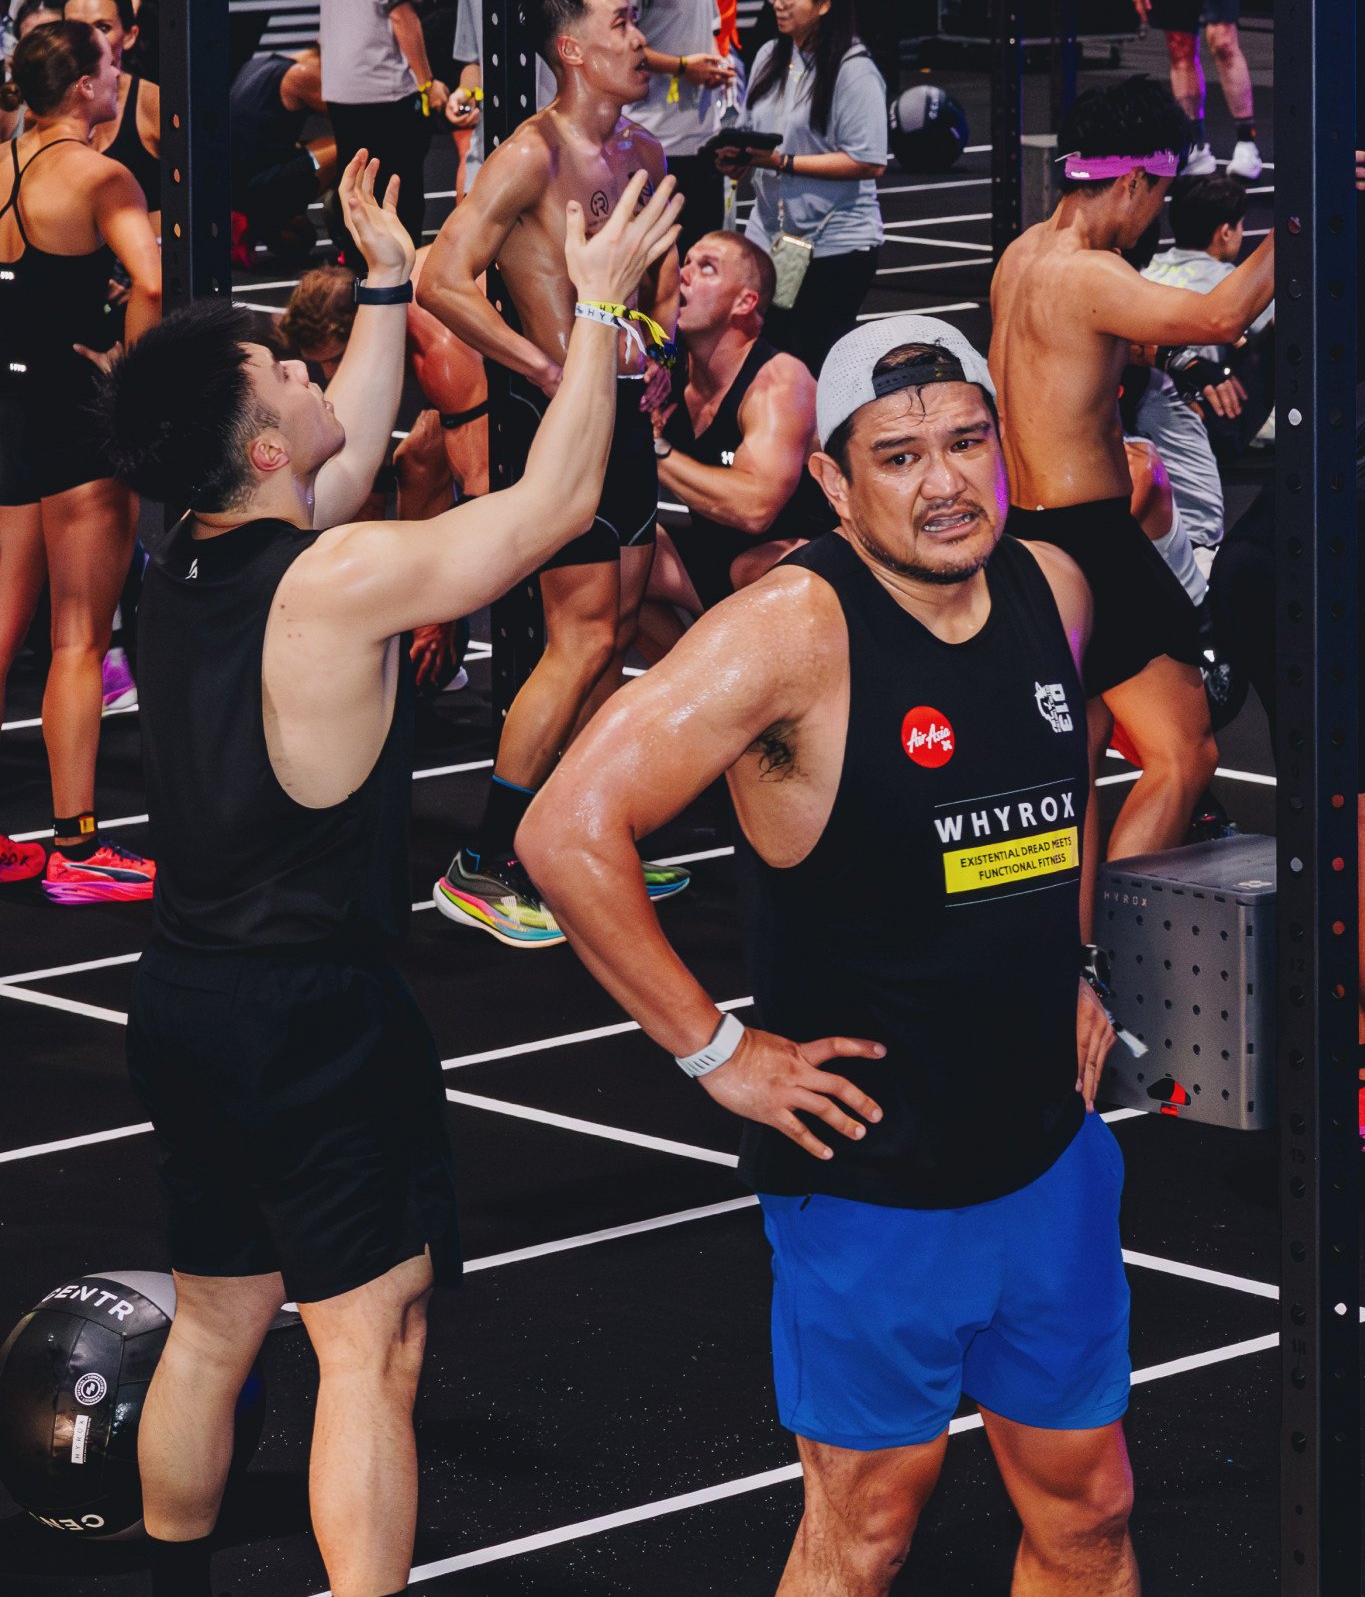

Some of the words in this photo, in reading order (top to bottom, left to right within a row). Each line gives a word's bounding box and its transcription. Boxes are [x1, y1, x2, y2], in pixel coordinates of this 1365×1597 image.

[907, 723, 951, 753] AirAsia
[934, 792, 1075, 843] WHYROX
[960, 849, 1021, 869] EXISTENTIAL
[1021, 842, 1050, 858] DREAD
[1051, 836, 1073, 850] MEETS
[978, 859, 1037, 881] FUNCTIONAL
[1038, 853, 1067, 869] FITNESS
[1104, 891, 1147, 907] HYROX
[38, 1514, 104, 1531] CEN
